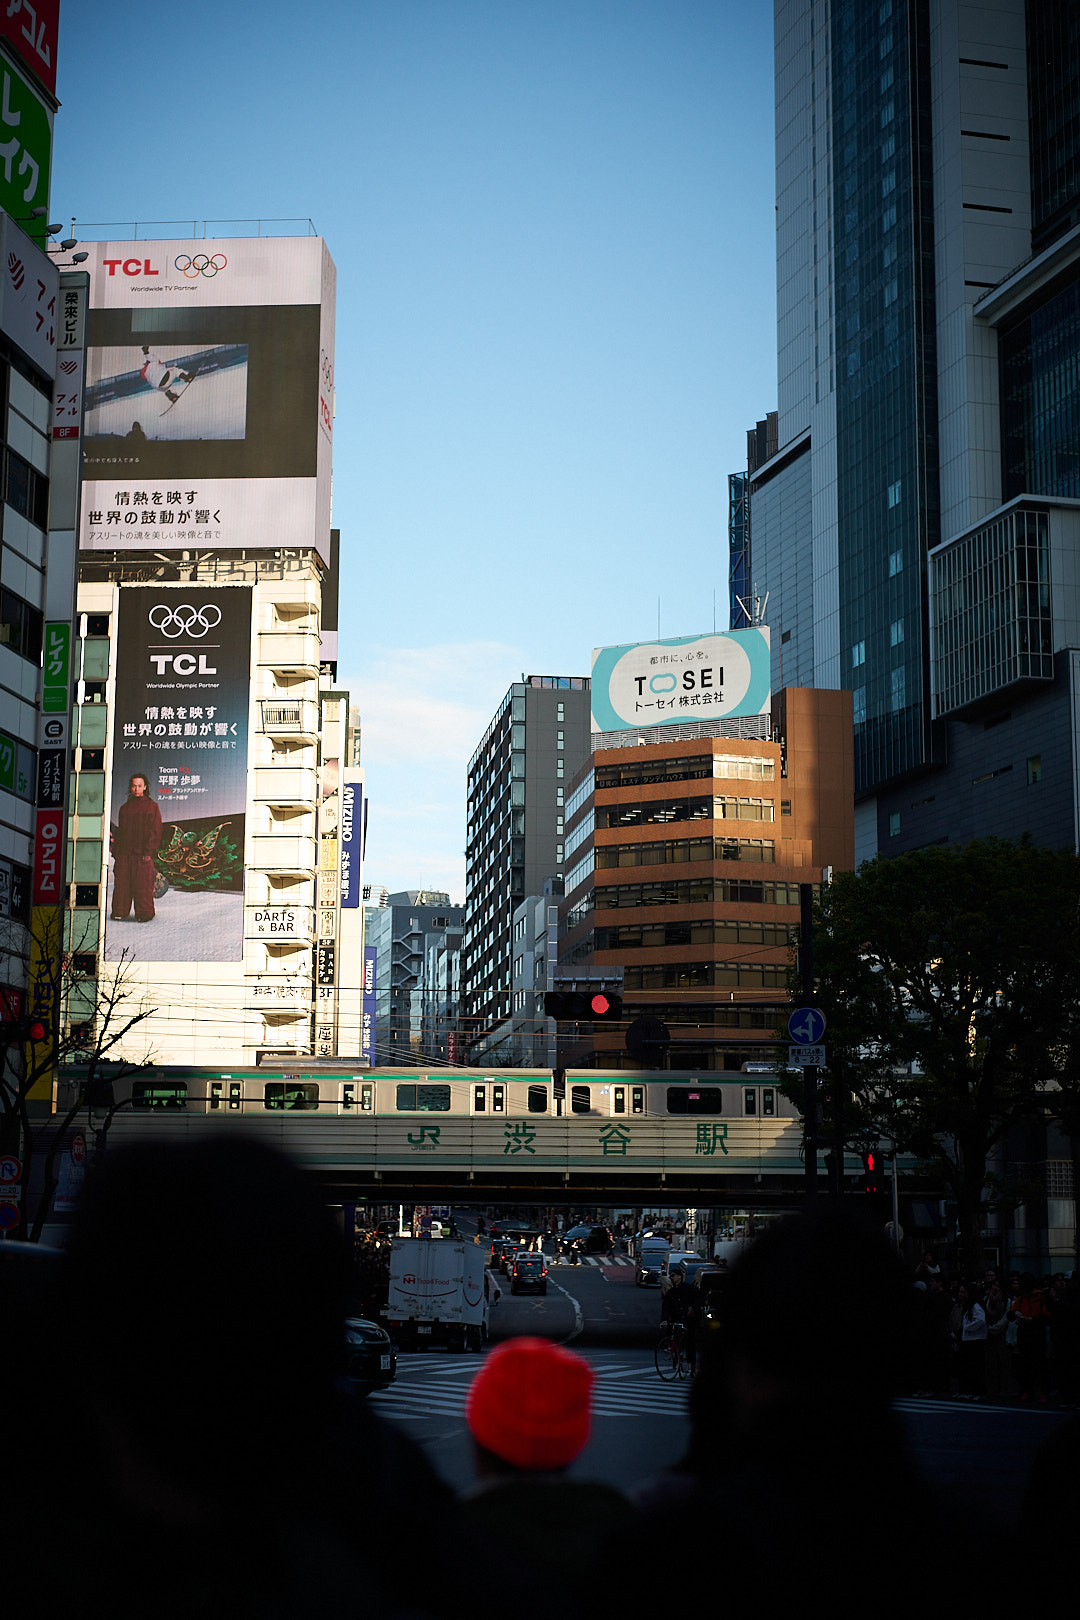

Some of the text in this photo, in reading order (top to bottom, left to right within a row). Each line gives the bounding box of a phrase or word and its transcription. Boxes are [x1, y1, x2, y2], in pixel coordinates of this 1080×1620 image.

[103, 259, 159, 276] TCL
[320, 395, 332, 432] TCL
[59, 428, 70, 437] 8F
[115, 490, 198, 505] 情熱を映す
[88, 509, 221, 525] 世界の鼓動が響く
[89, 530, 221, 540] アスリートの魂を美しい映像と音で
[48, 631, 64, 676] レイク
[150, 653, 217, 676] TCL
[634, 666, 724, 696] TOSEI
[635, 691, 724, 712] トーセイ株式会社
[144, 706, 217, 720] 情熱を映す
[123, 722, 238, 737] 世界の鼓動が響く
[123, 741, 236, 749] アスリートの魂を美しい映像と音で
[18, 772, 28, 793] 5F
[42, 759, 51, 797] クリニック
[158, 775, 201, 786] 平野 歩夢
[643, 773, 684, 783] ダンディハウス
[342, 786, 355, 842] MIZUHO
[40, 843, 56, 891] アコム
[255, 912, 295, 921] DARTS
[270, 922, 294, 931] BAR
[365, 959, 374, 995] MIZUHO
[319, 987, 332, 997] 3F
[408, 1121, 728, 1155] JR 渋谷駅
